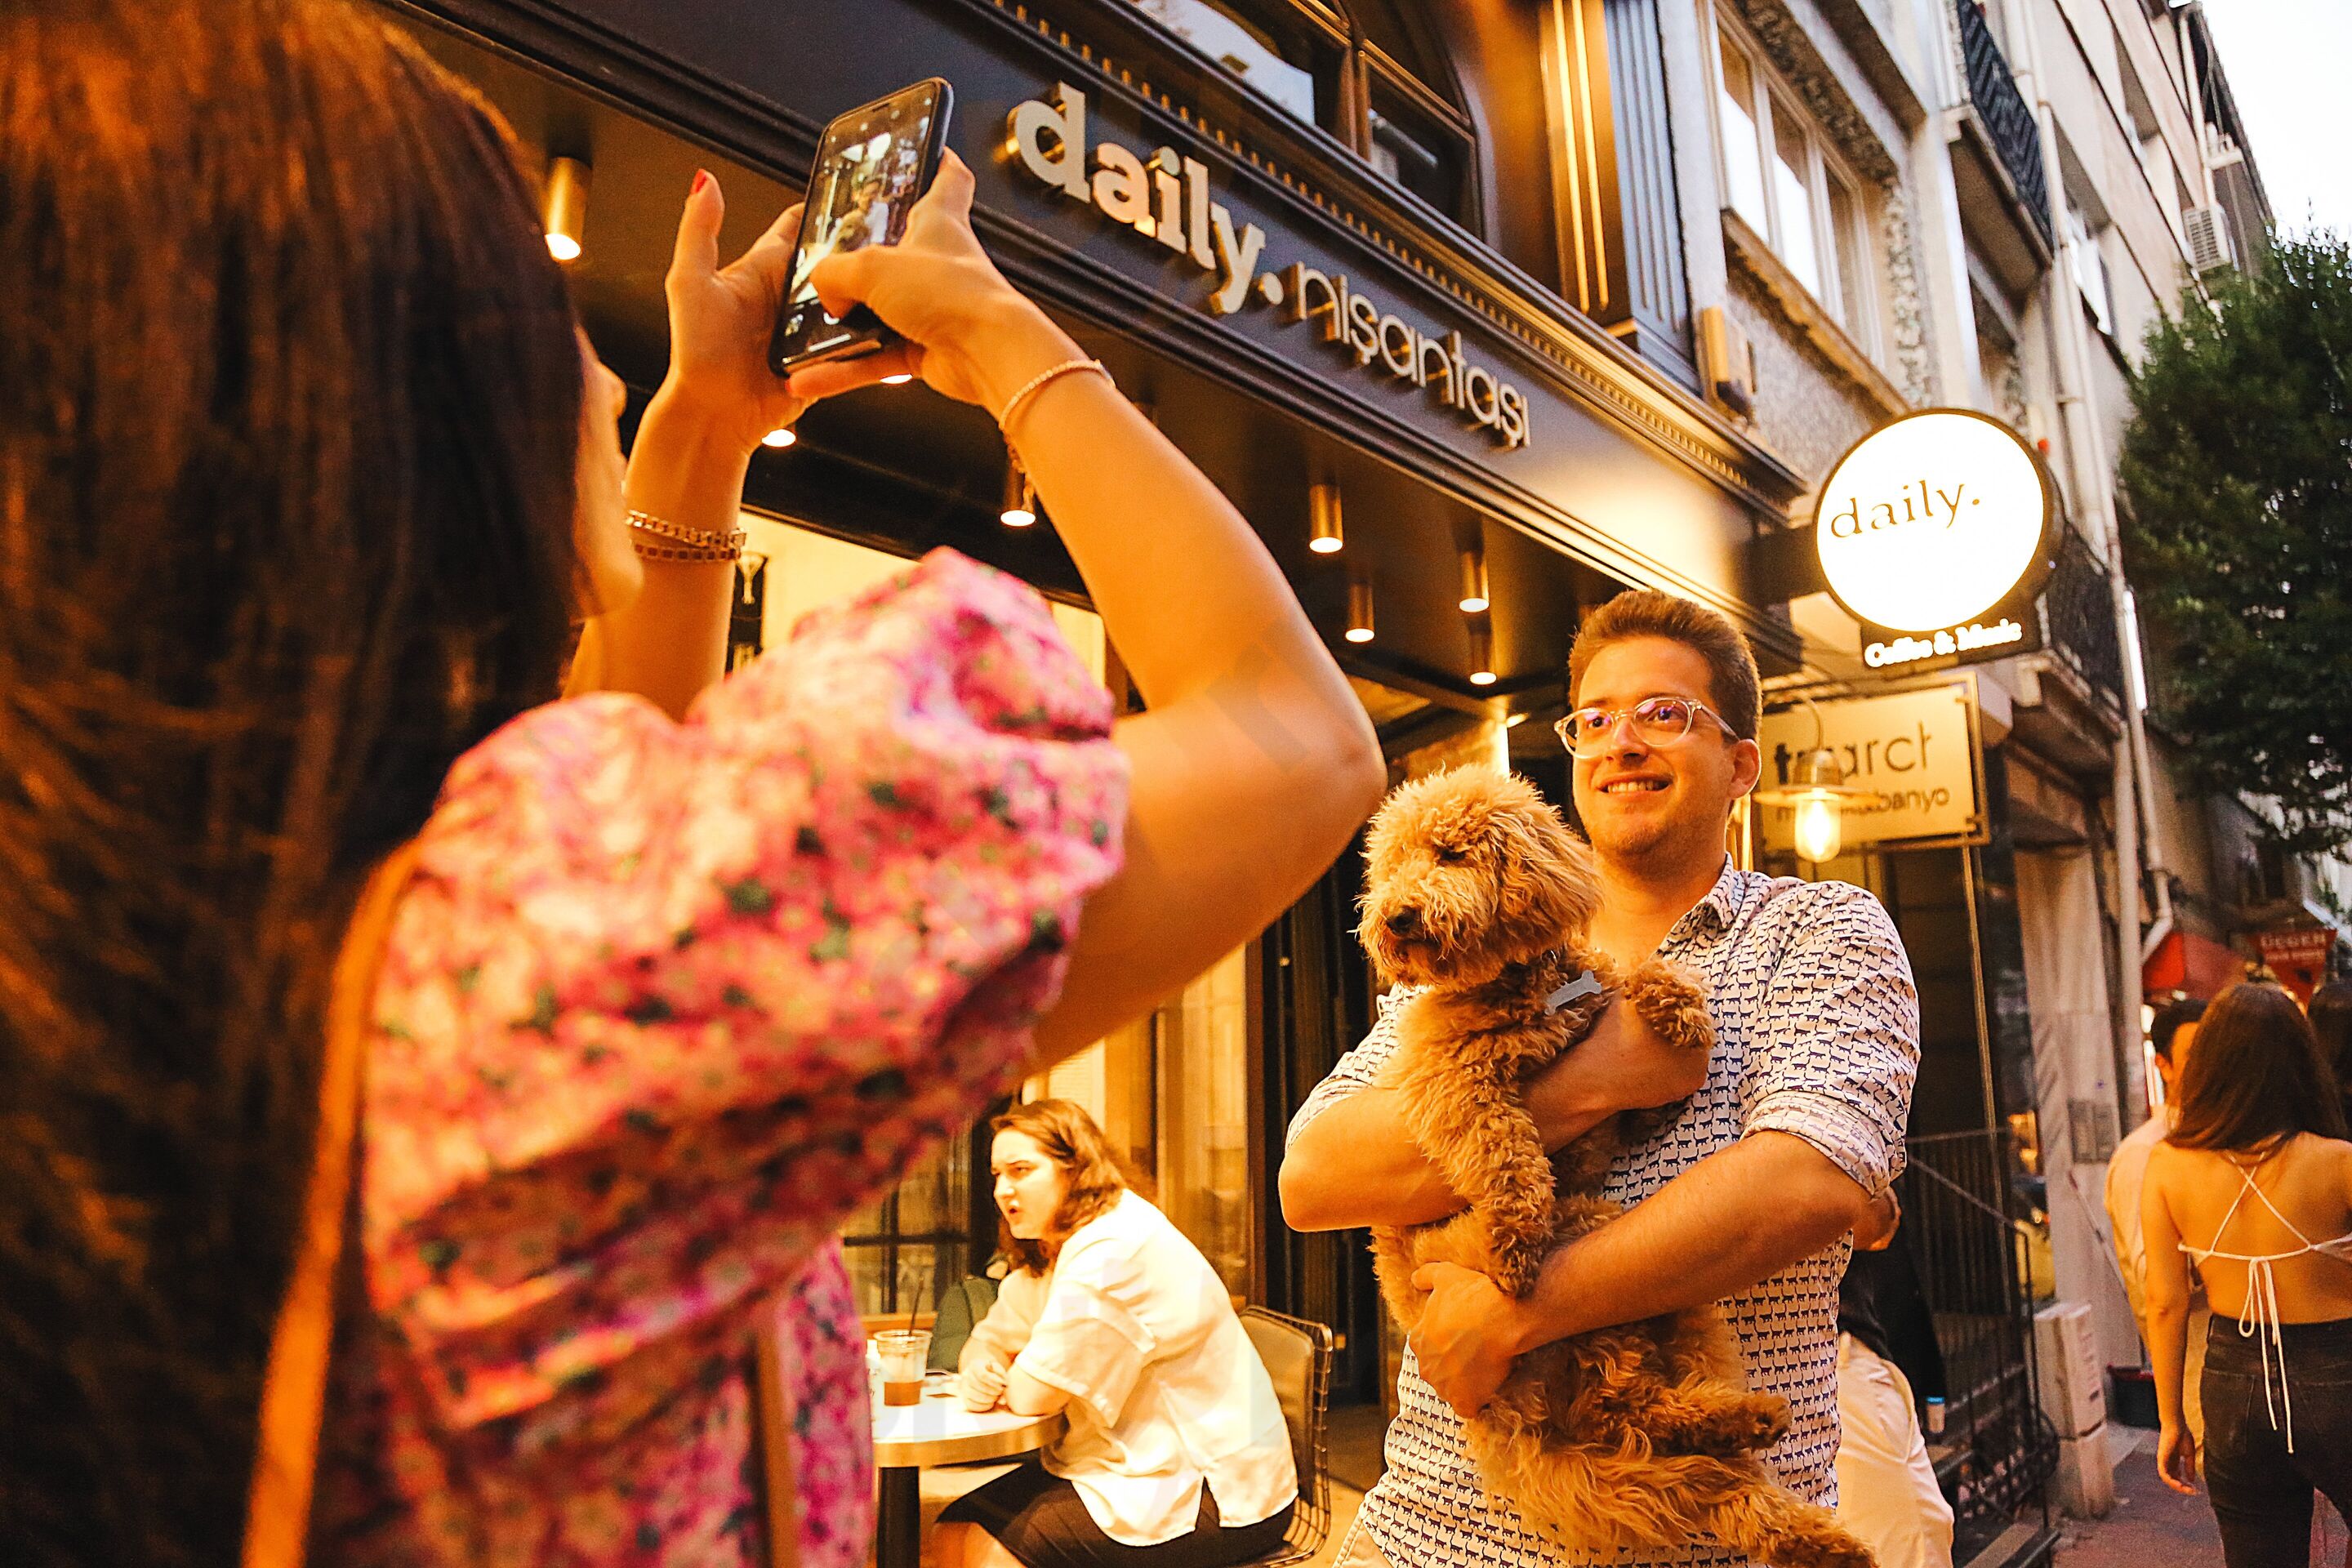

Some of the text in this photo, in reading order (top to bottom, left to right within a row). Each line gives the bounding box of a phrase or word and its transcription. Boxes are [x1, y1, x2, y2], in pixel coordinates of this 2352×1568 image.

[1830, 479, 1980, 538] daily.
[1934, 630, 1957, 656] &
[1955, 618, 2022, 651] Music
